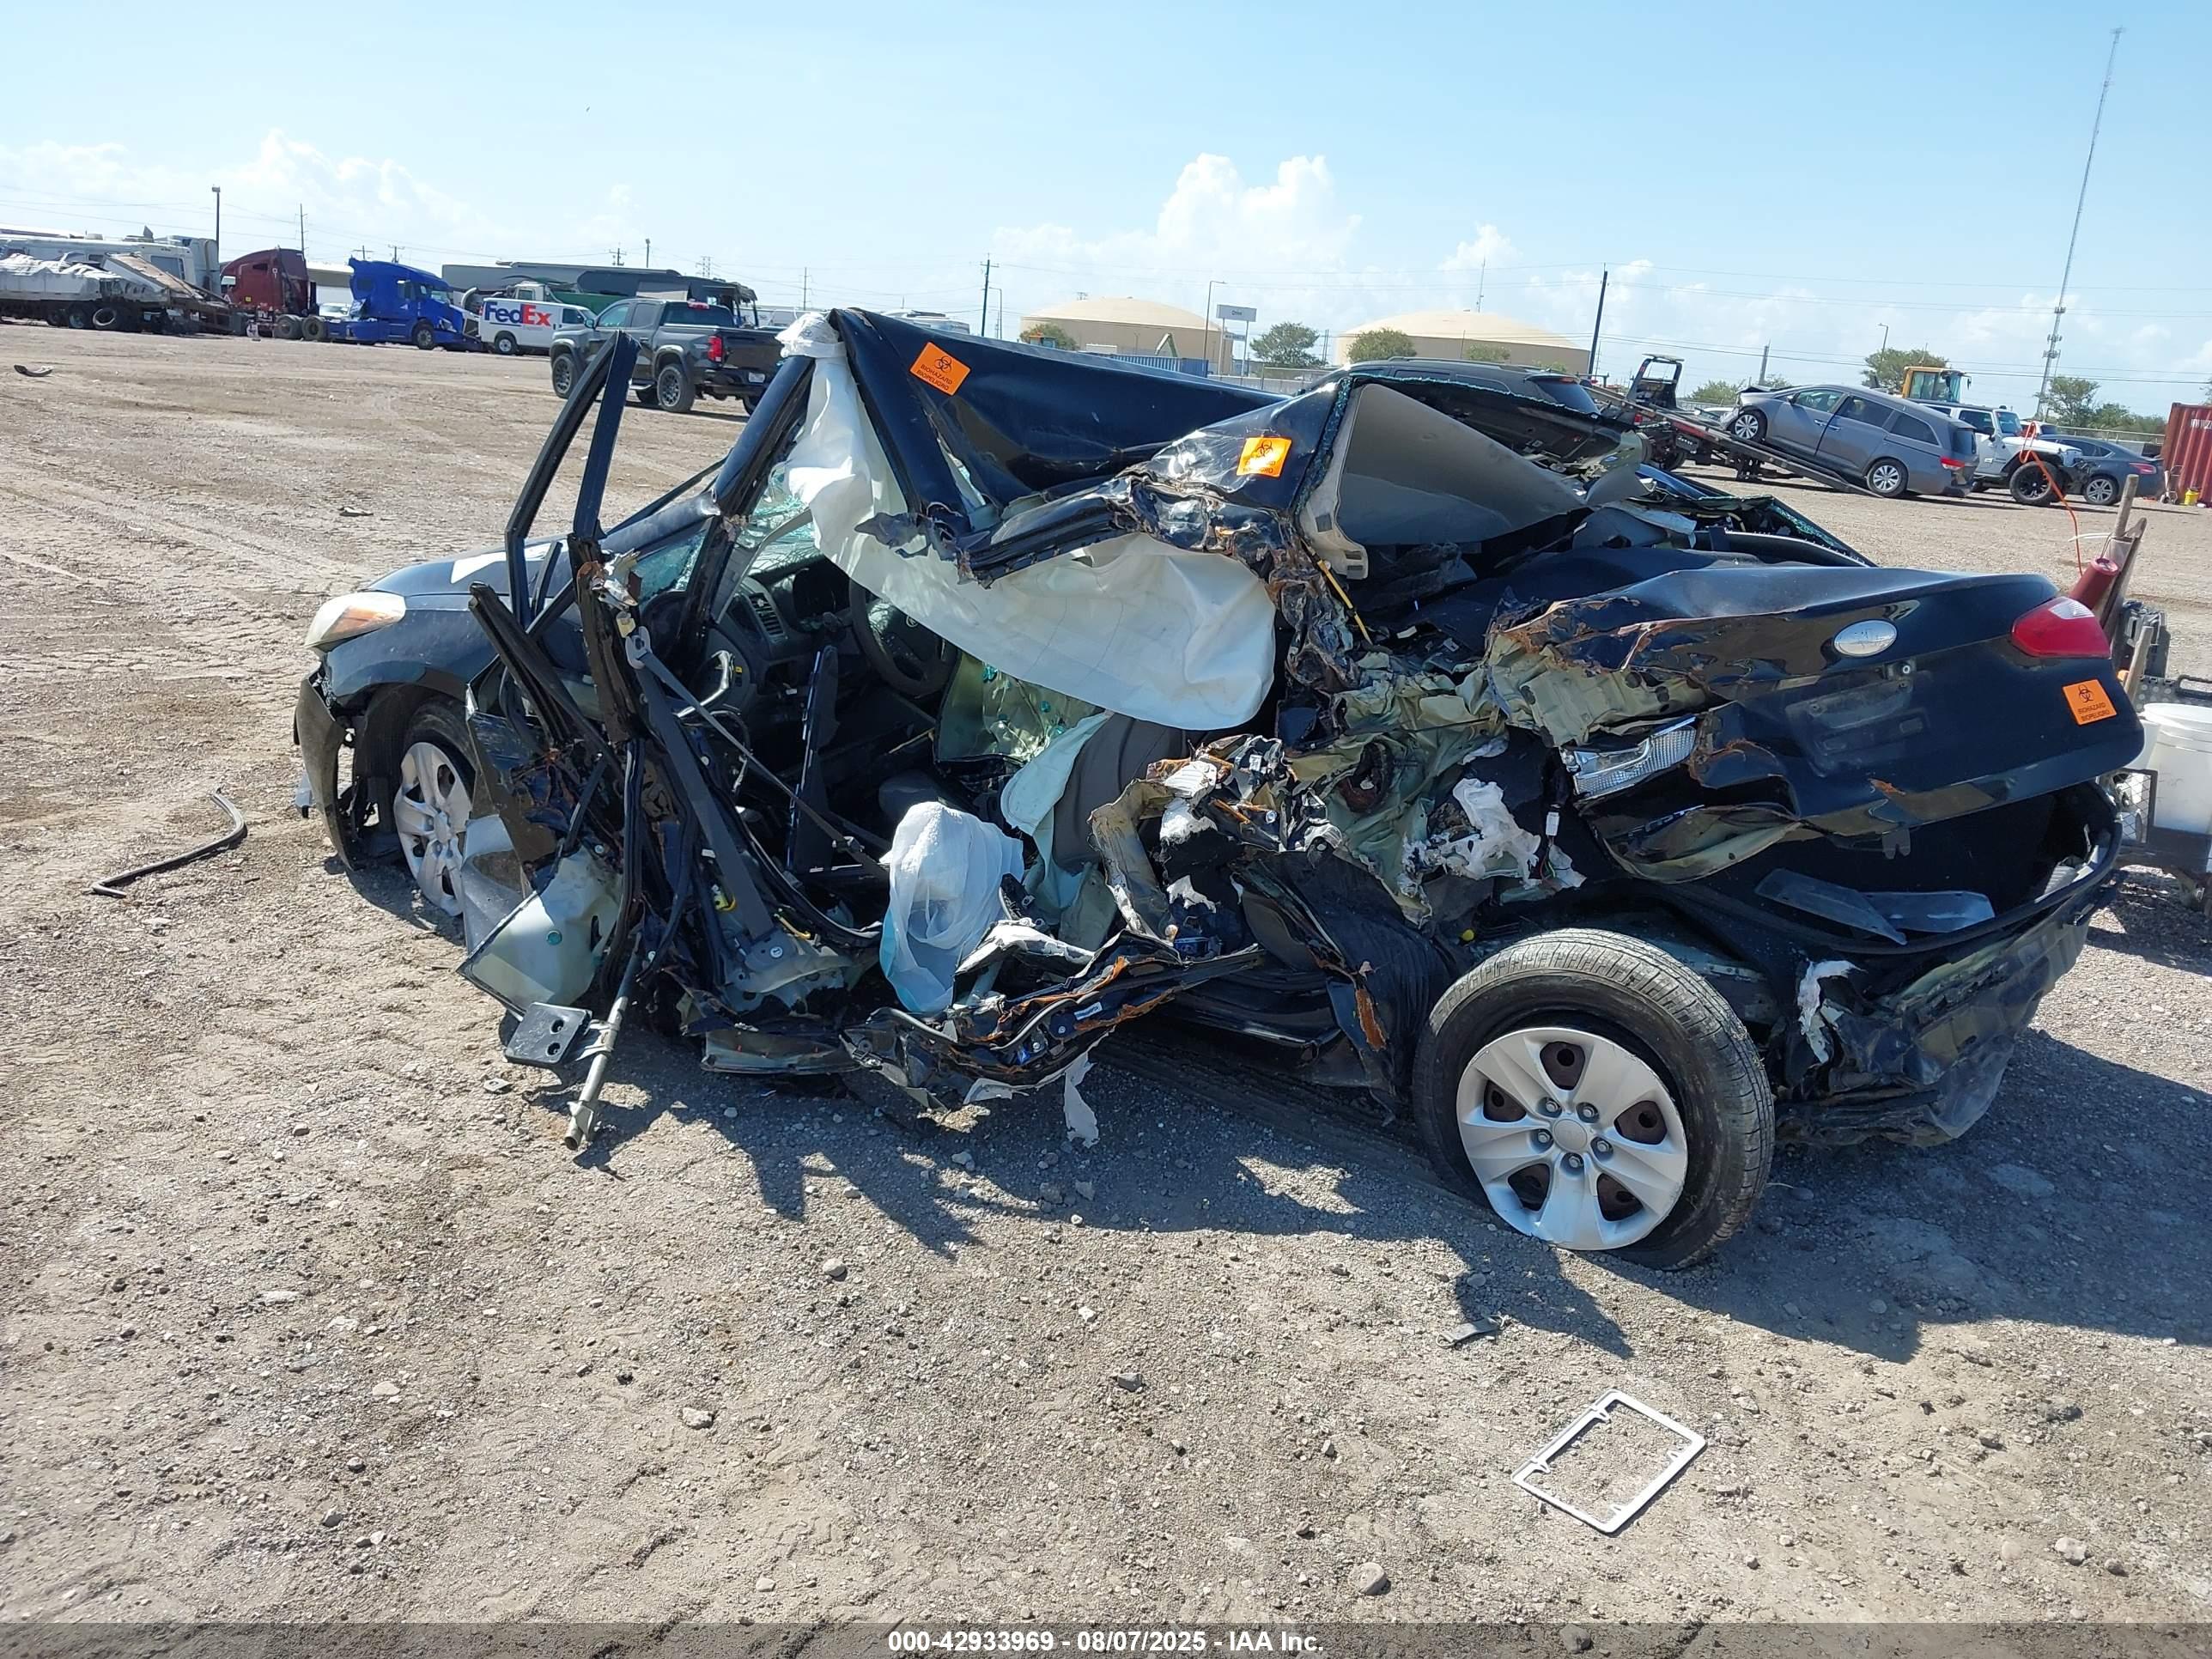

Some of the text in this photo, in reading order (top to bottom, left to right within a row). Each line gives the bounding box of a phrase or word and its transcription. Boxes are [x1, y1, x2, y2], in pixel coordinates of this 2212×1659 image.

[484, 301, 552, 326] FedEx
[916, 369, 950, 391] BIOPELIGRO
[920, 363, 953, 385] BIOHAZARD
[2077, 702, 2106, 714] BIOHAZARD
